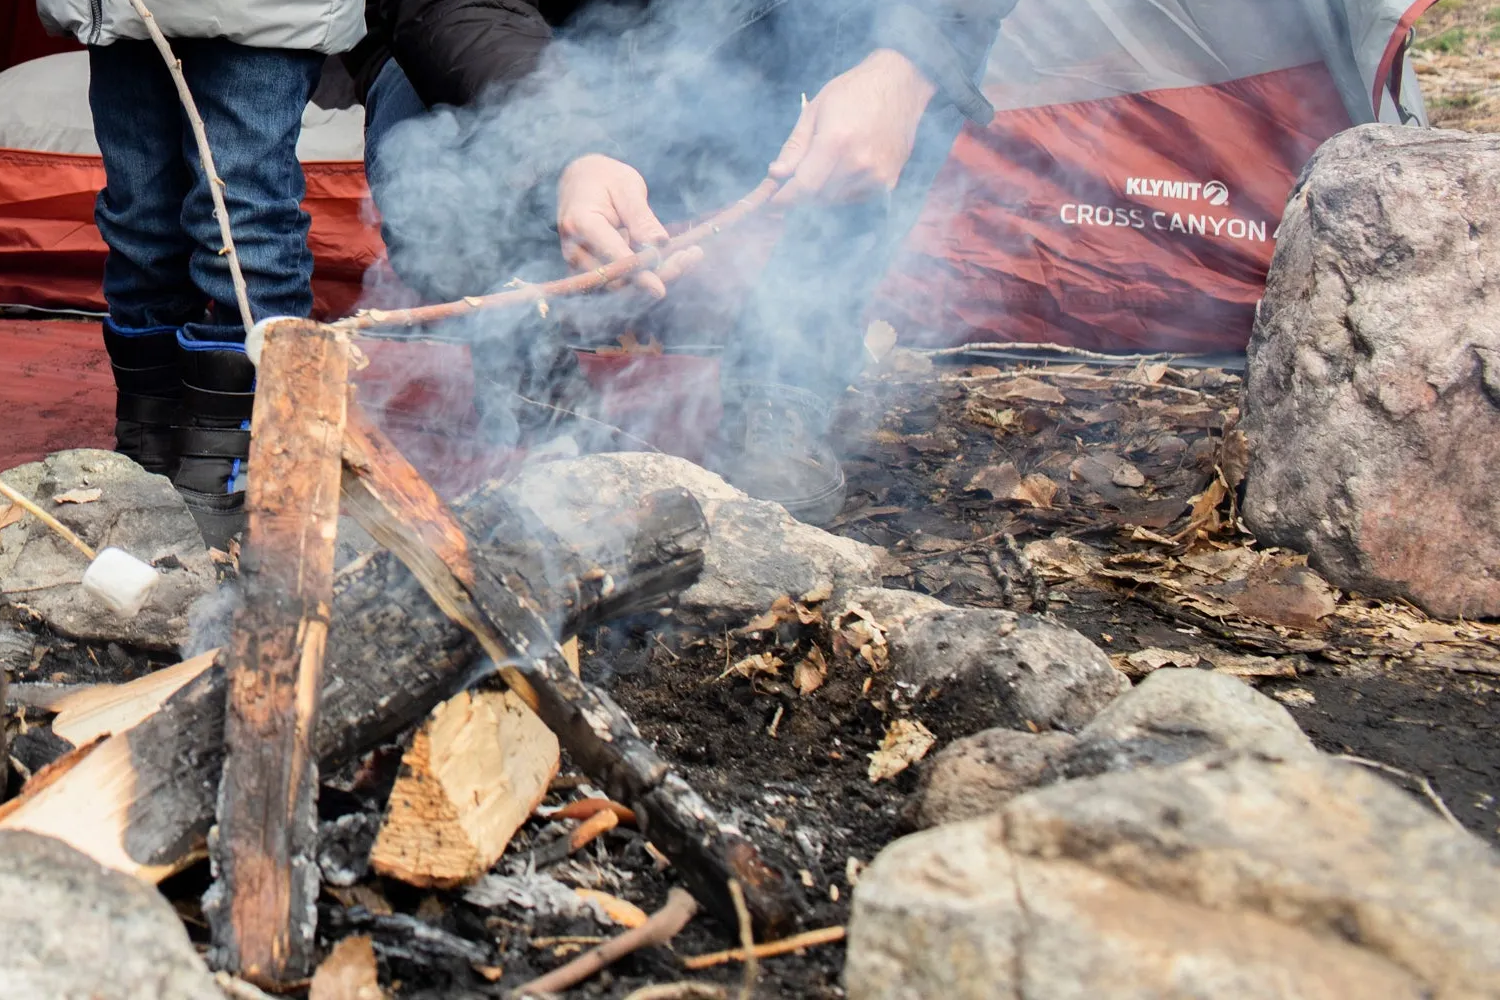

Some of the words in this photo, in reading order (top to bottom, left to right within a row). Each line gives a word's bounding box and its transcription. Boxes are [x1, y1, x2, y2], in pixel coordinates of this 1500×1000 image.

[1126, 177, 1201, 200] KLYMIT
[1059, 203, 1145, 229] CROSS
[1151, 211, 1266, 242] CANYON
